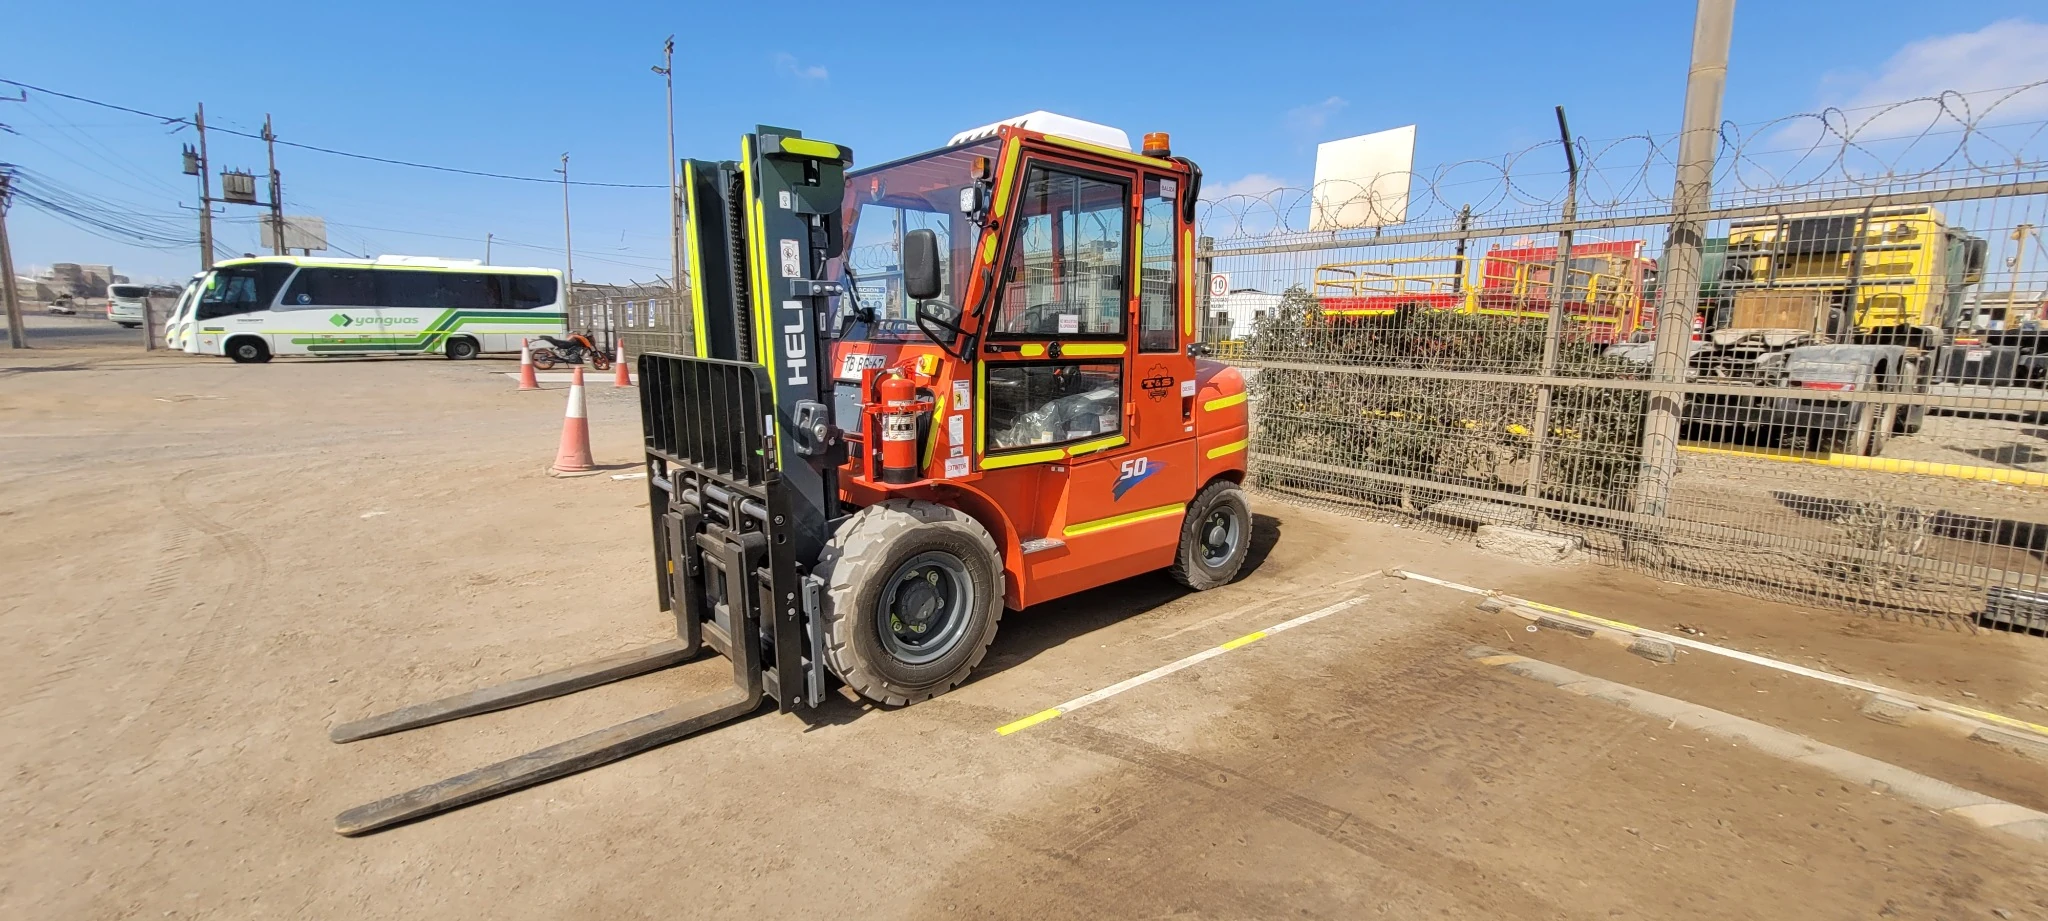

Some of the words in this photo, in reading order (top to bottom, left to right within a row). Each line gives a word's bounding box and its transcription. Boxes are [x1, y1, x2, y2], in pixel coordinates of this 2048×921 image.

[1213, 279, 1224, 290] 10
[355, 317, 419, 327] yanguas
[783, 300, 808, 385] HELI
[1119, 457, 1148, 480] 50
